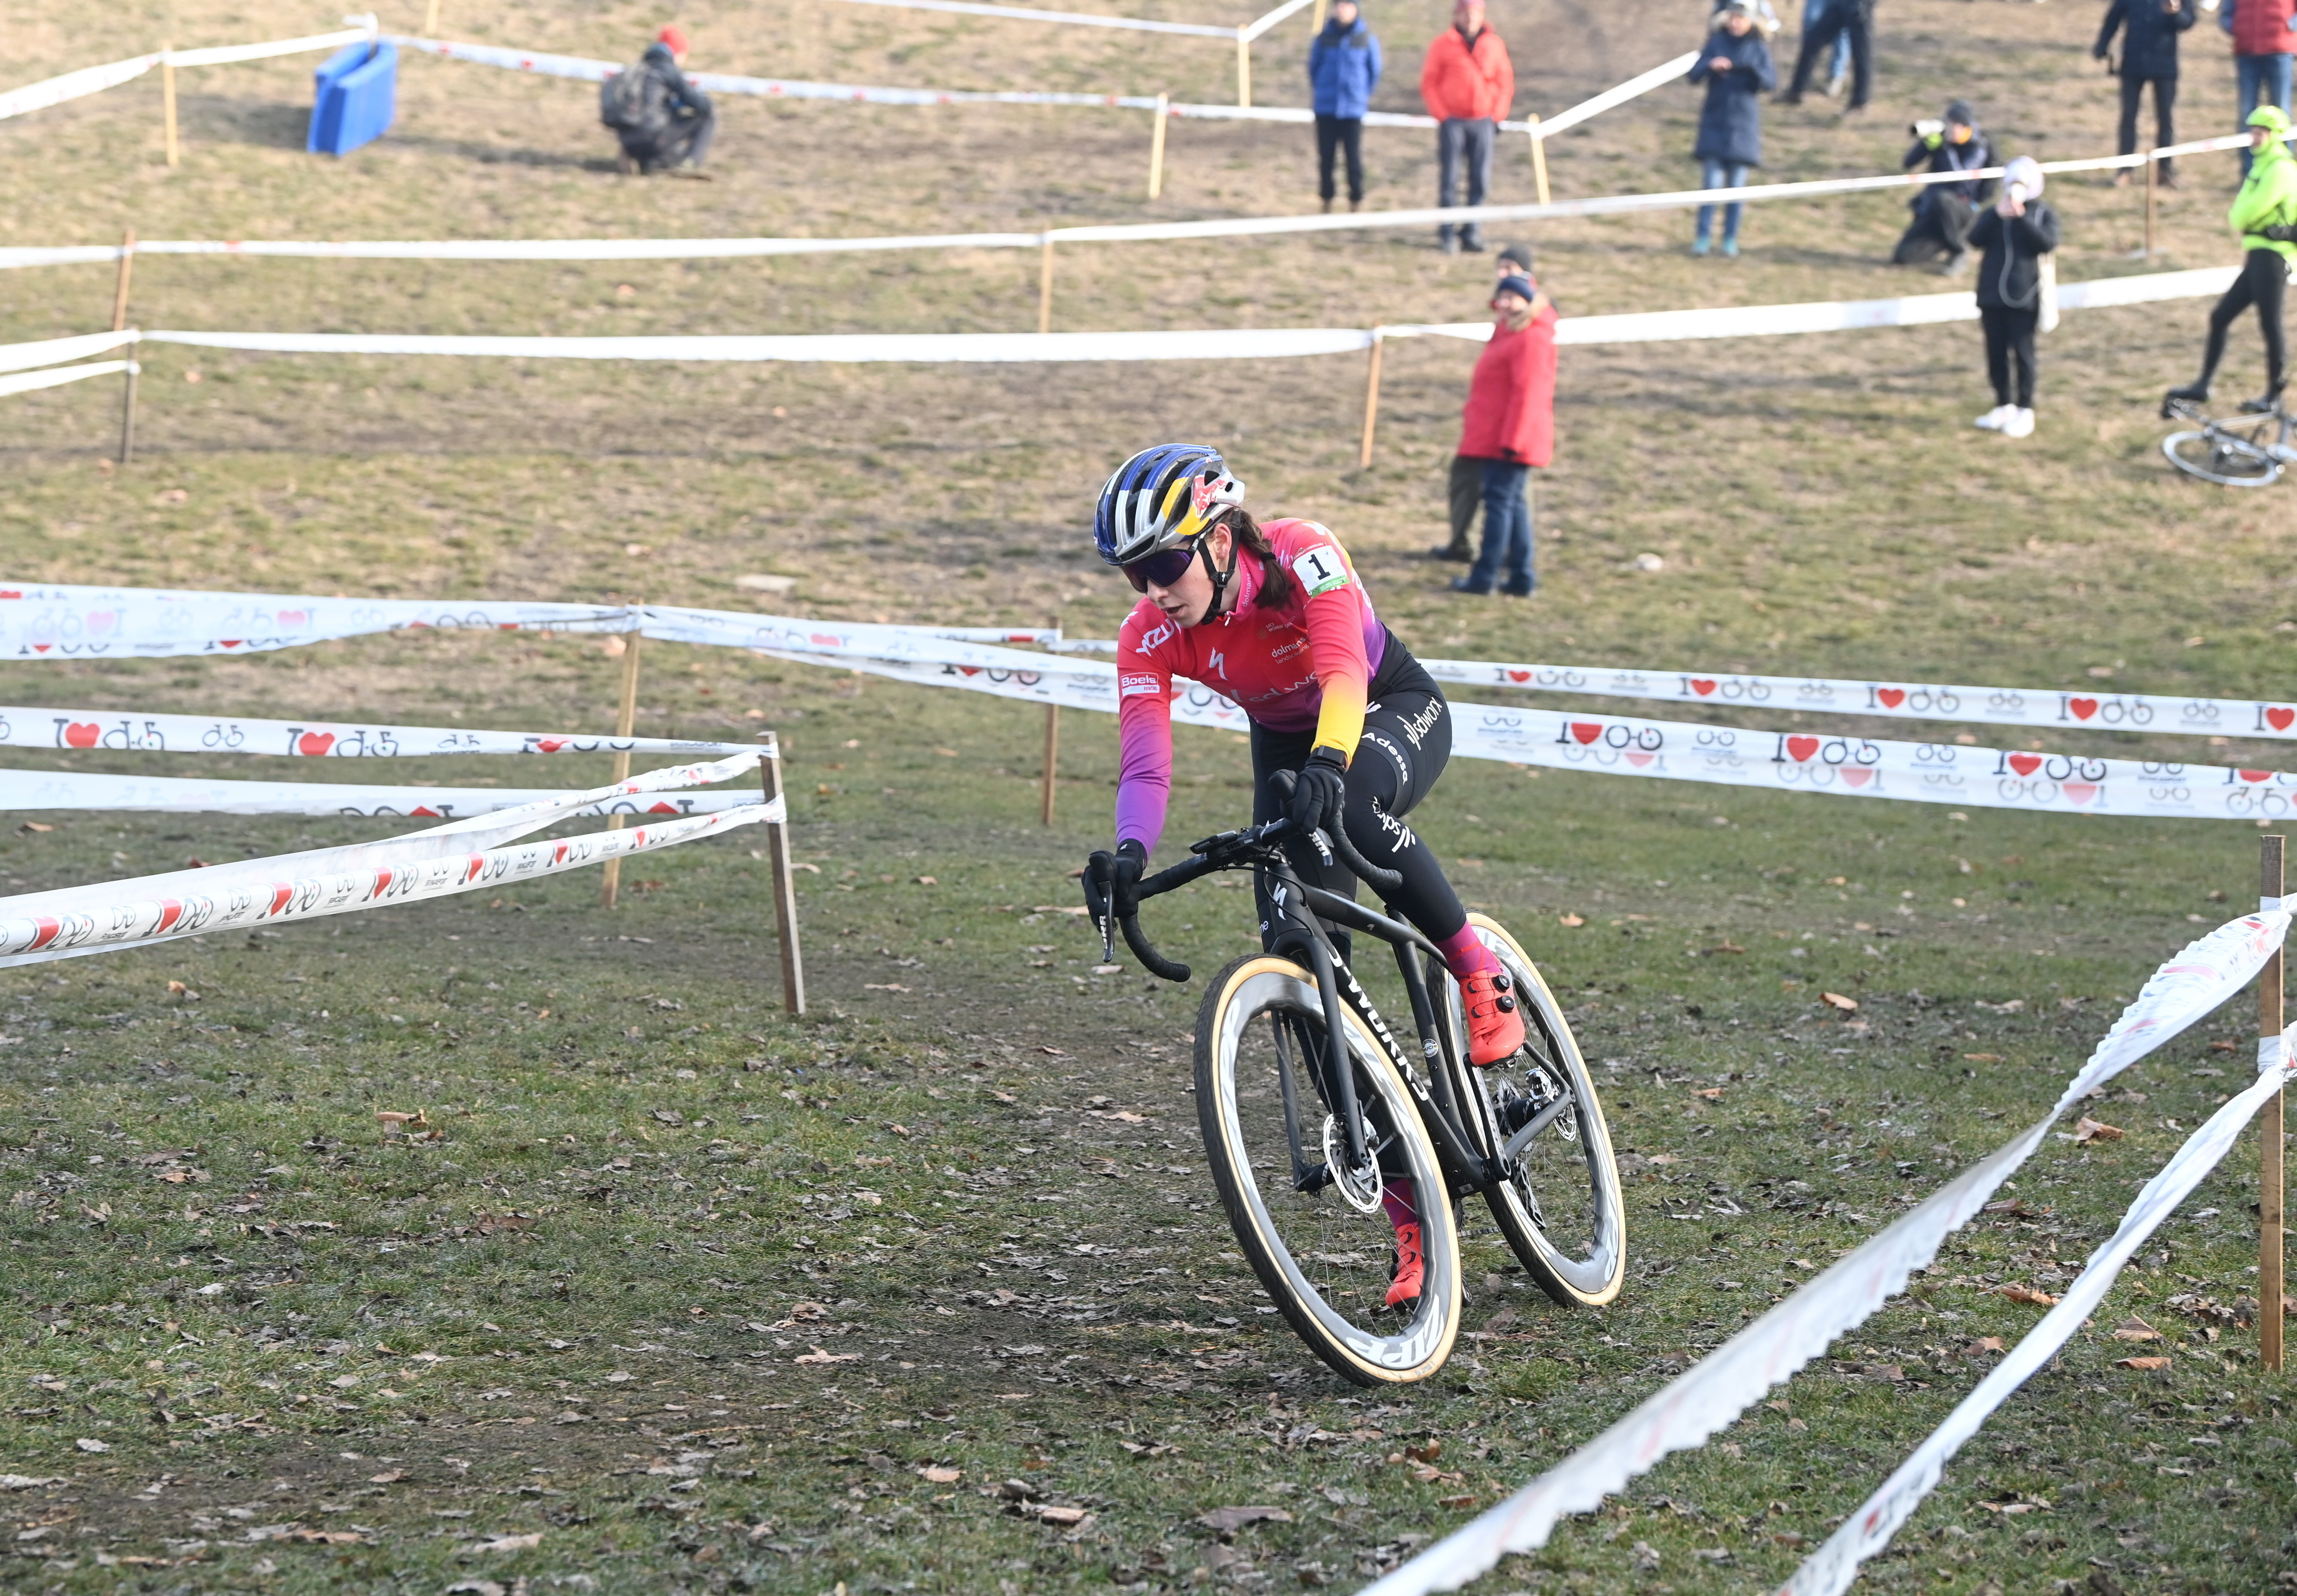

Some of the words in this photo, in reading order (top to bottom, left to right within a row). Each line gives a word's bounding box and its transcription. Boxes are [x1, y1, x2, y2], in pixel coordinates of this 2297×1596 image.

[1308, 553, 1331, 580] 1
[1242, 572, 1252, 607] dolmans
[1271, 636, 1306, 657] dolmans
[1275, 643, 1310, 664] landscaping
[1121, 675, 1156, 687] Boels
[2254, 703, 2266, 731] I
[1361, 732, 1408, 786] Adessa
[1346, 1292, 1445, 1368] ZIPP
